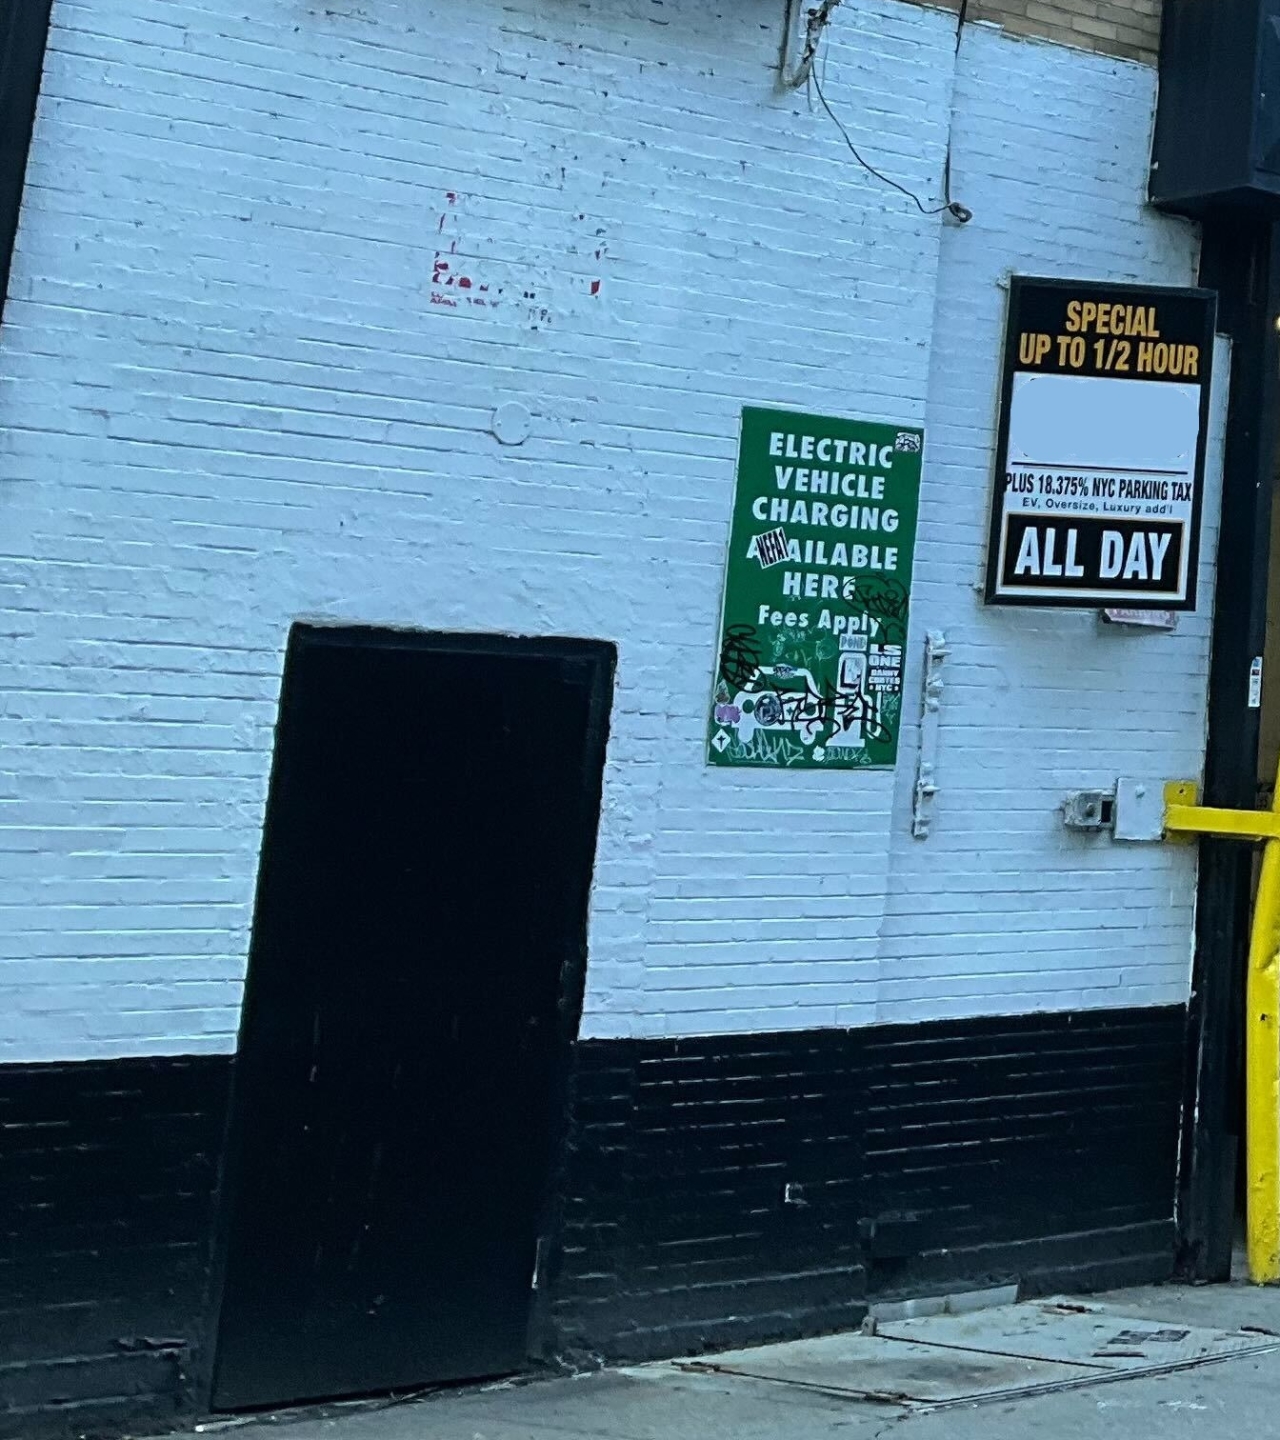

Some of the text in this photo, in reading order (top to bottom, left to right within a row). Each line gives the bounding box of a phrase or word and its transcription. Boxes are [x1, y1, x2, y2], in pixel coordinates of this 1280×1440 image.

[1066, 301, 1159, 338] SPECIAL
[1019, 333, 1198, 376] UP TO 1/2 HOUR
[769, 432, 893, 469] ELECTRIC
[775, 466, 885, 500] VEHICLE
[1006, 472, 1192, 501] PLUS 18.375% NYC PARKING TAX
[752, 496, 899, 533] CHARGING
[1022, 497, 1041, 509] EV,
[1045, 498, 1099, 512] Oversize,
[1103, 502, 1141, 514] Luxury
[746, 535, 898, 571] AAILABLE
[1014, 526, 1172, 580] ALL DAY
[782, 572, 856, 600] HERE
[758, 604, 882, 638] Fees Apply
[869, 655, 901, 668] ONE
